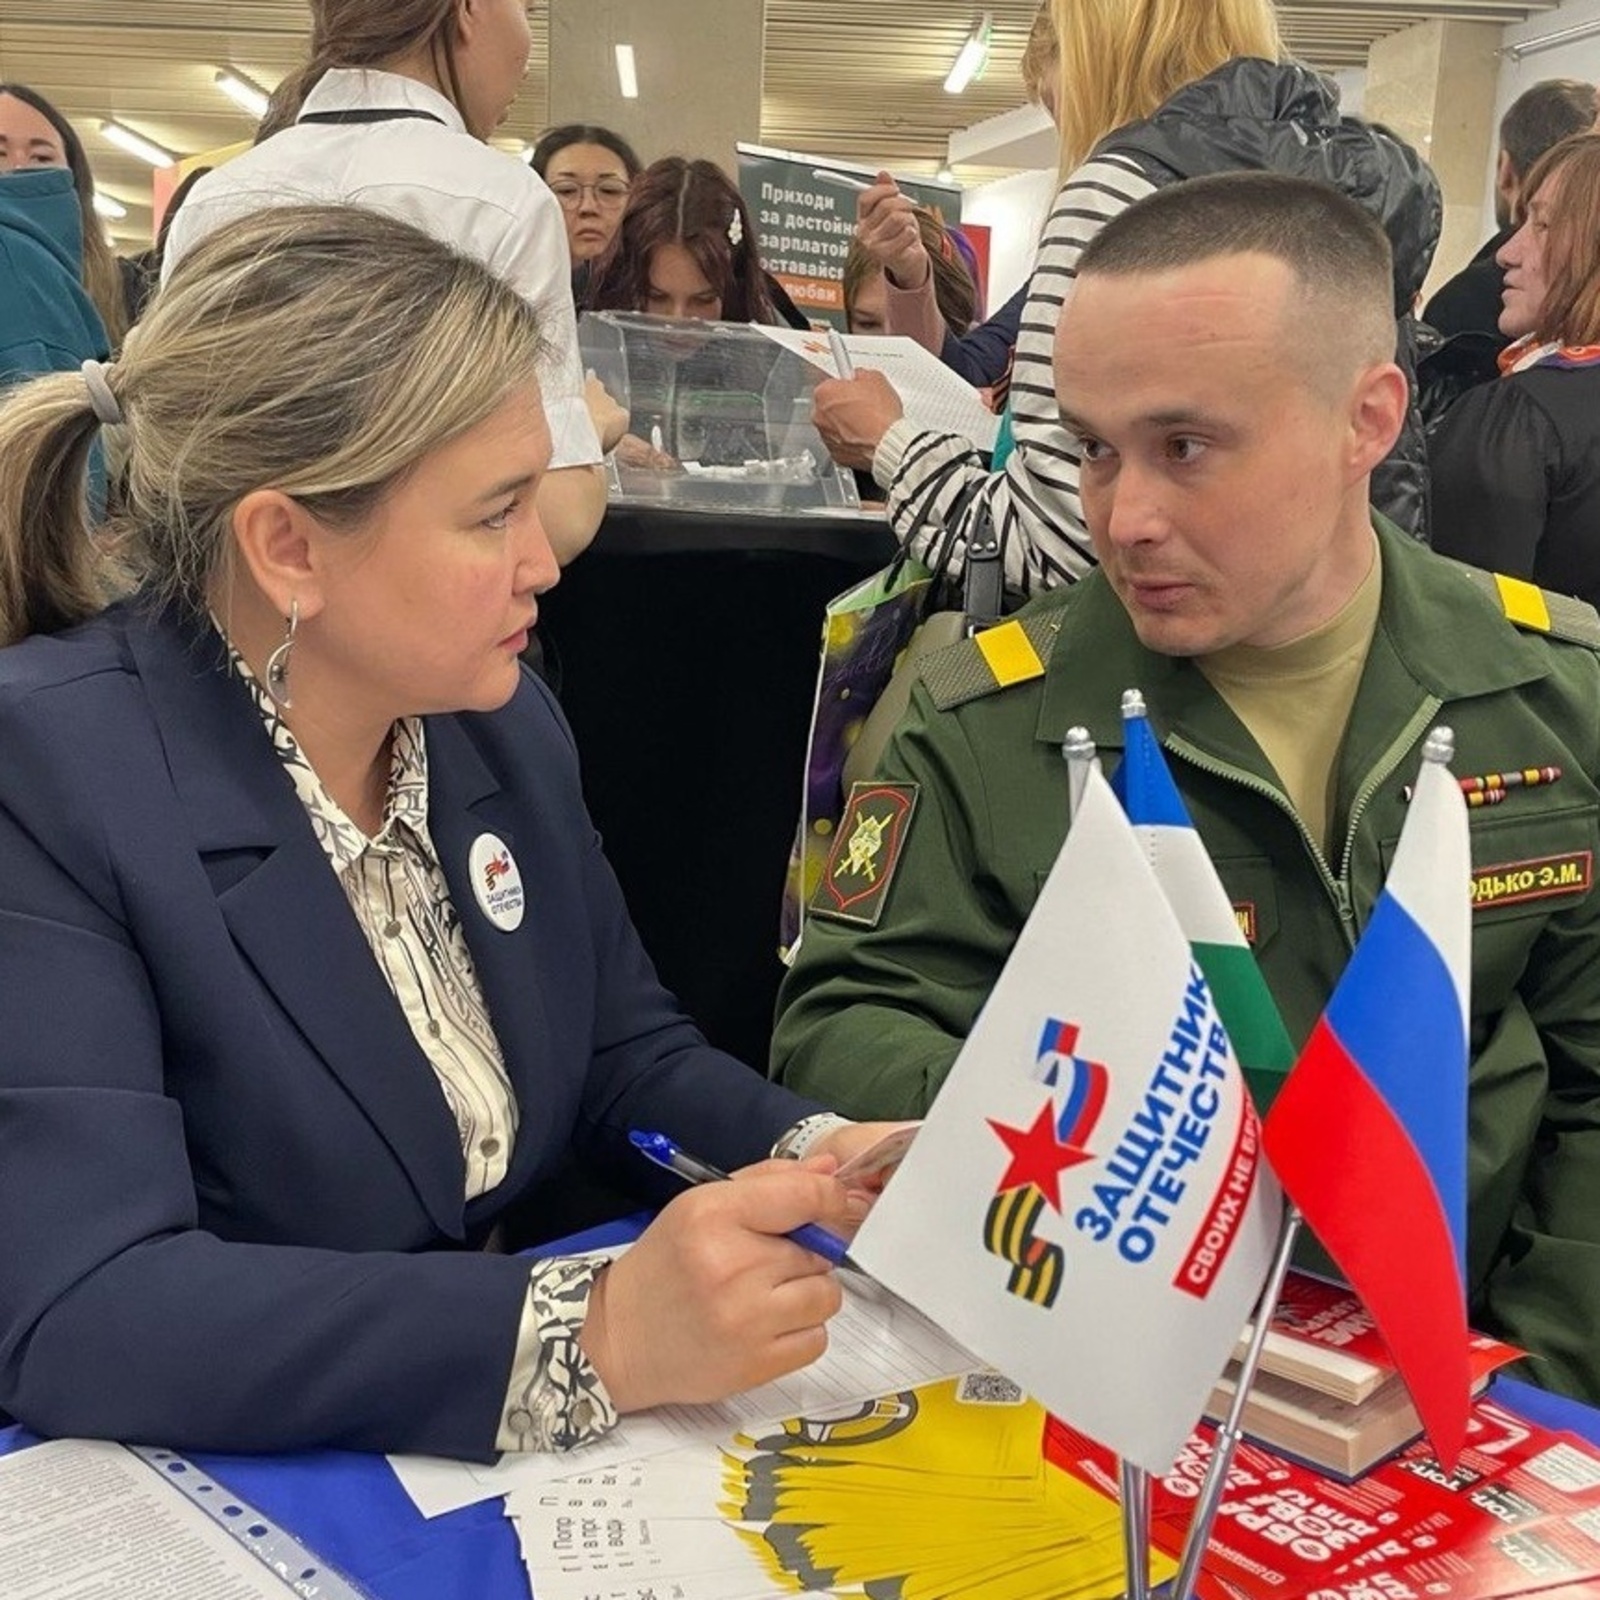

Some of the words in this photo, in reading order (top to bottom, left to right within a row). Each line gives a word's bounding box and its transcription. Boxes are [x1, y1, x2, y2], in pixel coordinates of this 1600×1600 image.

[761, 183, 835, 210] Приходи
[760, 210, 780, 225] за
[759, 233, 849, 258] зарплатой
[1539, 863, 1583, 886] Э.М.
[1188, 1194, 1241, 1283] СВОИХ
[1229, 1154, 1253, 1192] НЕ
